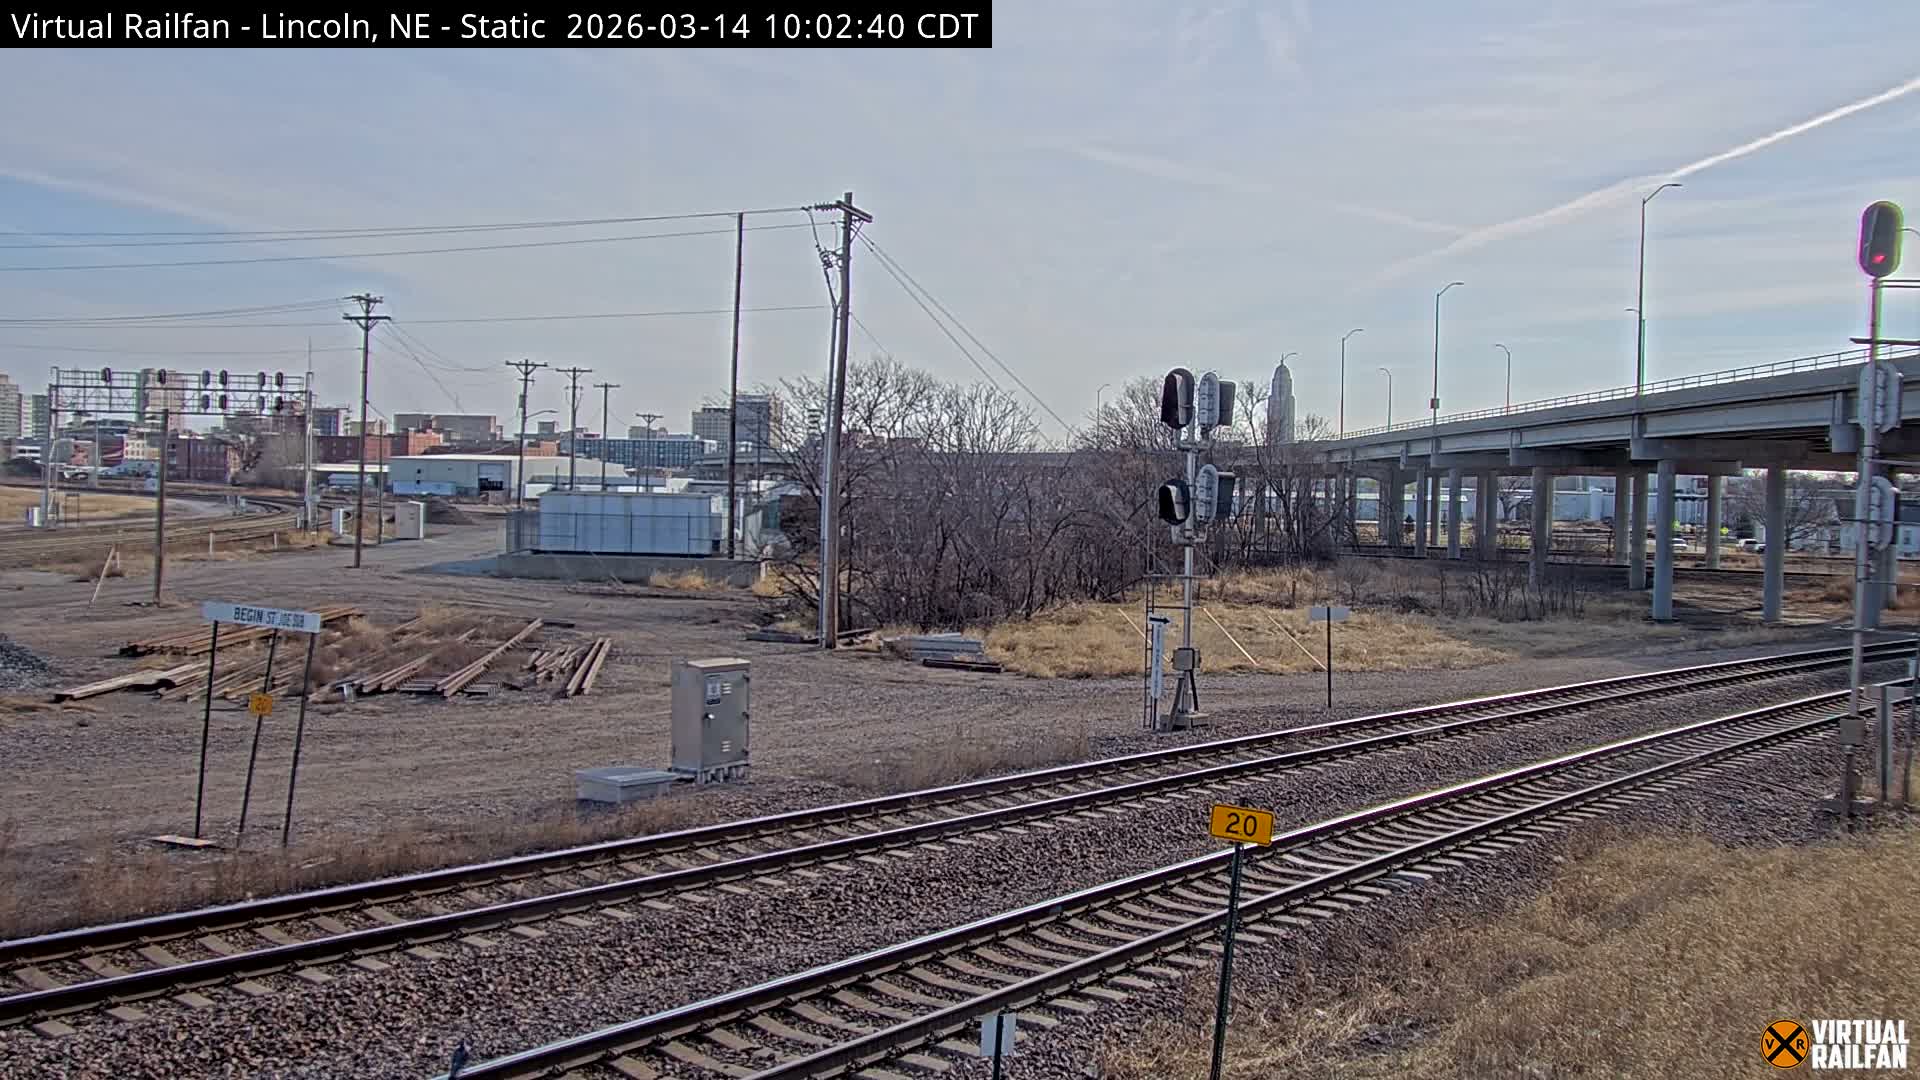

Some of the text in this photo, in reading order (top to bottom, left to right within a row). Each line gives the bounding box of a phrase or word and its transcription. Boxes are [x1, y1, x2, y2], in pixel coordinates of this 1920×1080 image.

[233, 607, 264, 623] BEGIN
[265, 611, 276, 625] ST
[1225, 812, 1257, 837] 20
